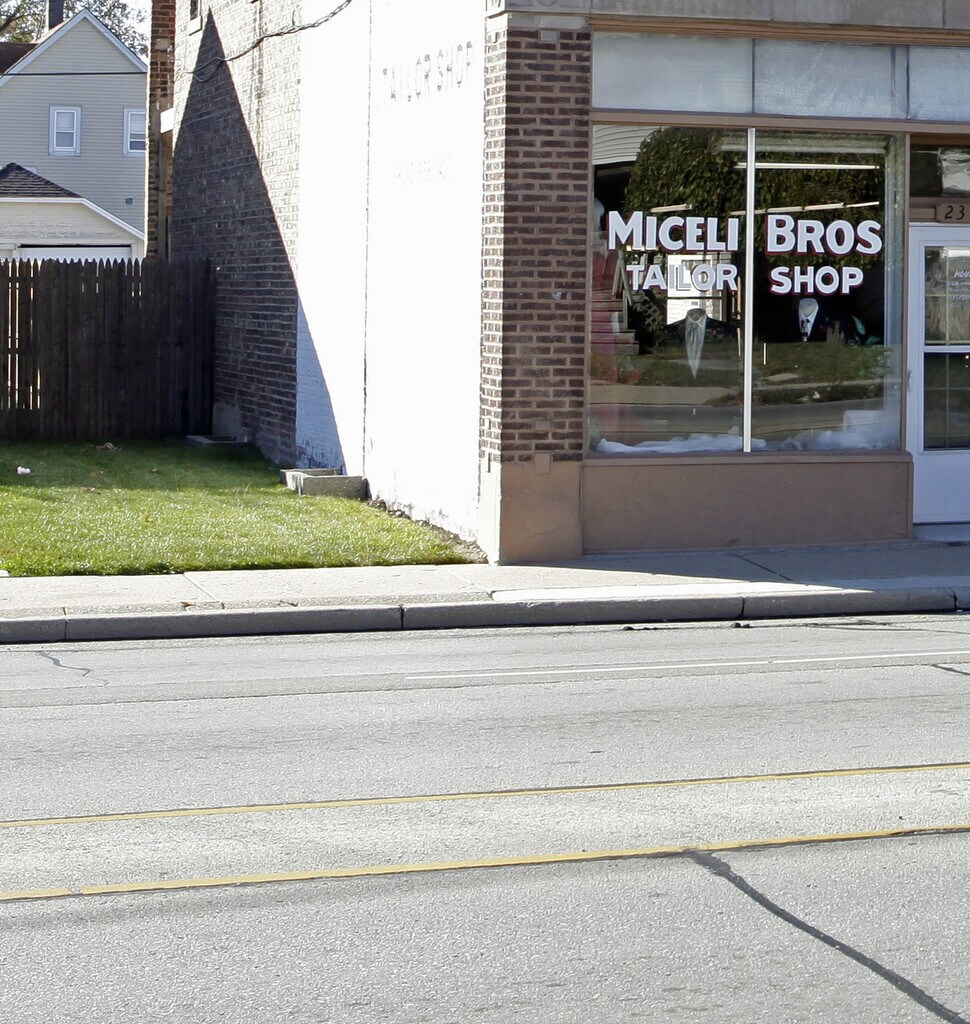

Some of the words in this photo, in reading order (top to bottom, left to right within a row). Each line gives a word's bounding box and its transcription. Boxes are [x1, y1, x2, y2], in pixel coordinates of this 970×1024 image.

[607, 210, 739, 252] MICELI
[765, 214, 883, 256] BROS
[626, 264, 738, 292] TAILOR
[770, 265, 864, 295] SHOP
